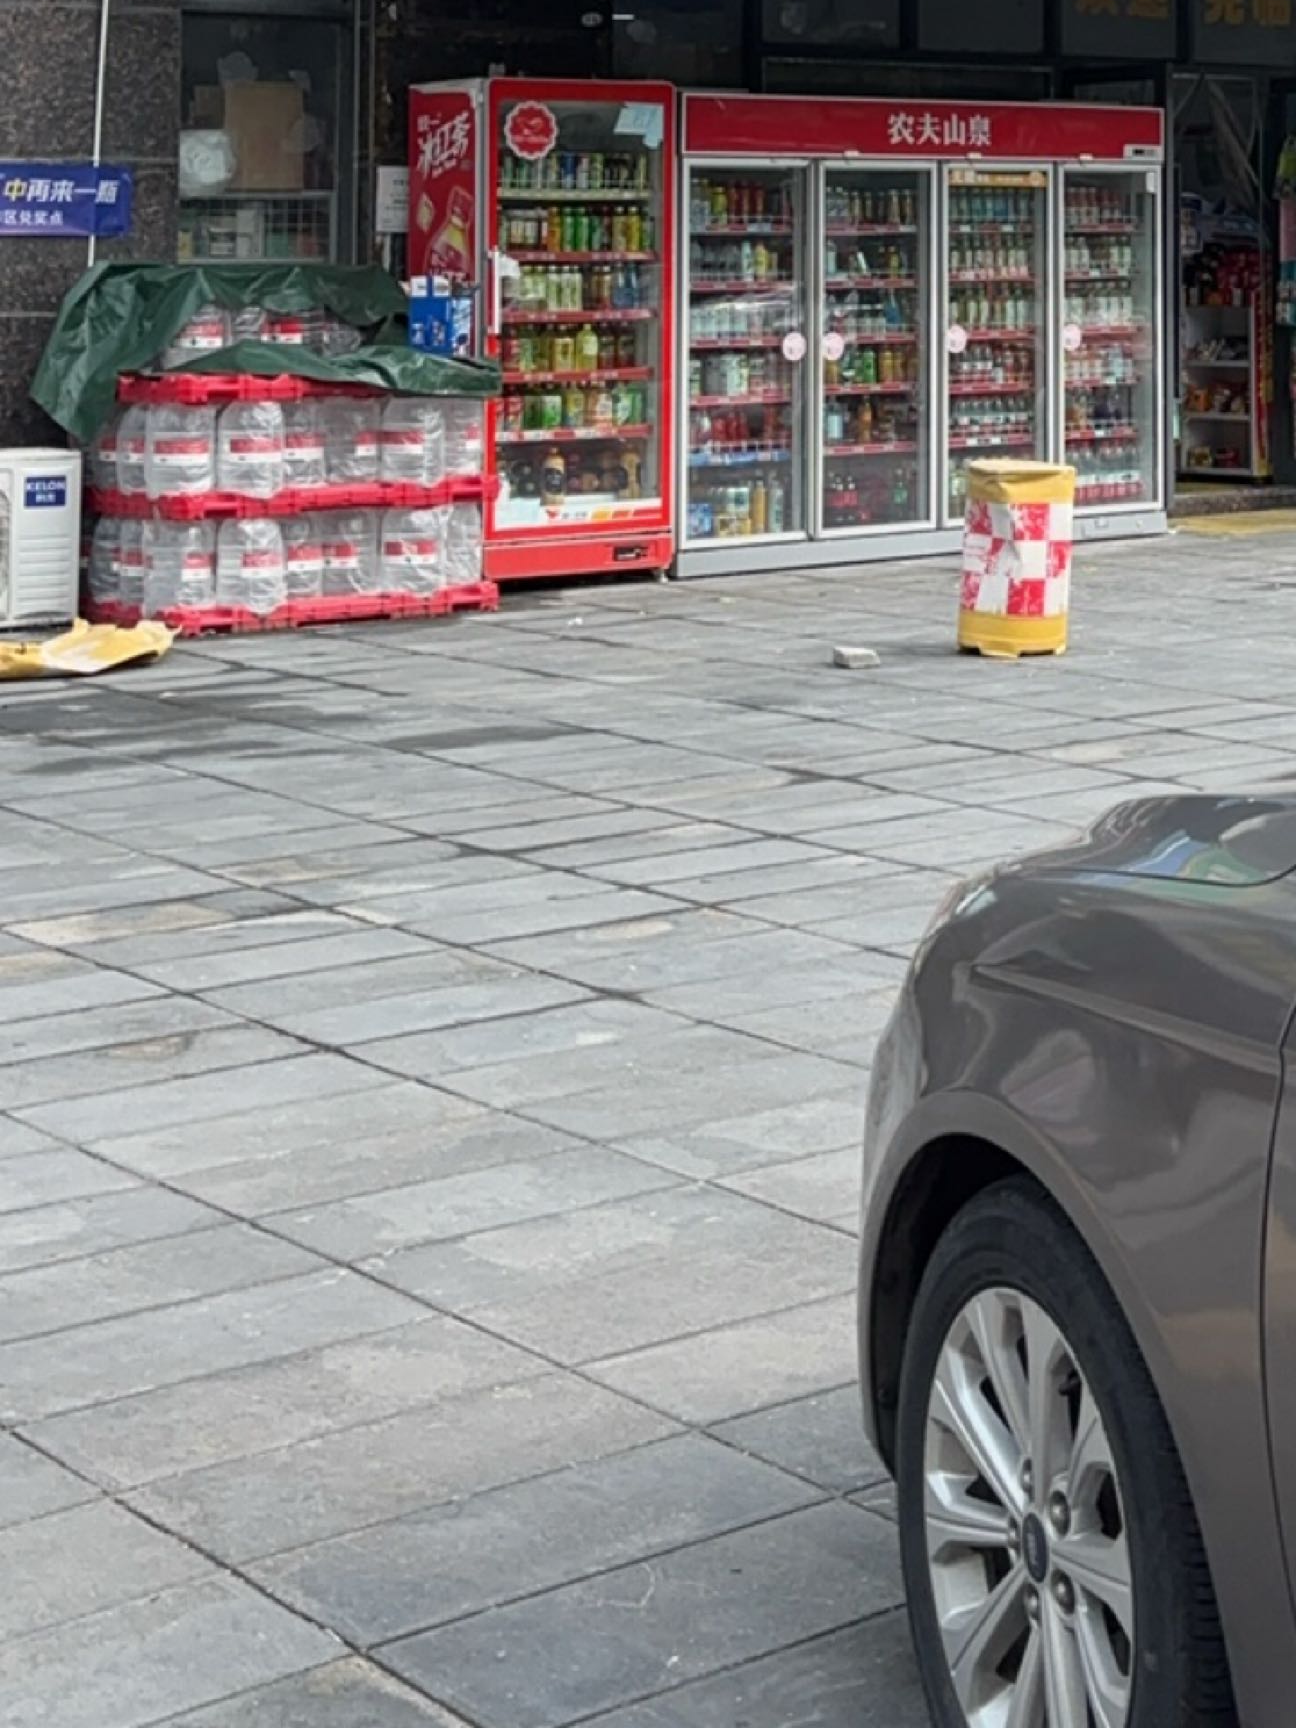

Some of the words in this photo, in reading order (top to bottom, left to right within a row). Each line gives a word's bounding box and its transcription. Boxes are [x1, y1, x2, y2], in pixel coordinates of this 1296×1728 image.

[887, 112, 992, 147] 农夫山泉
[0, 209, 63, 226] 区兑奖点
